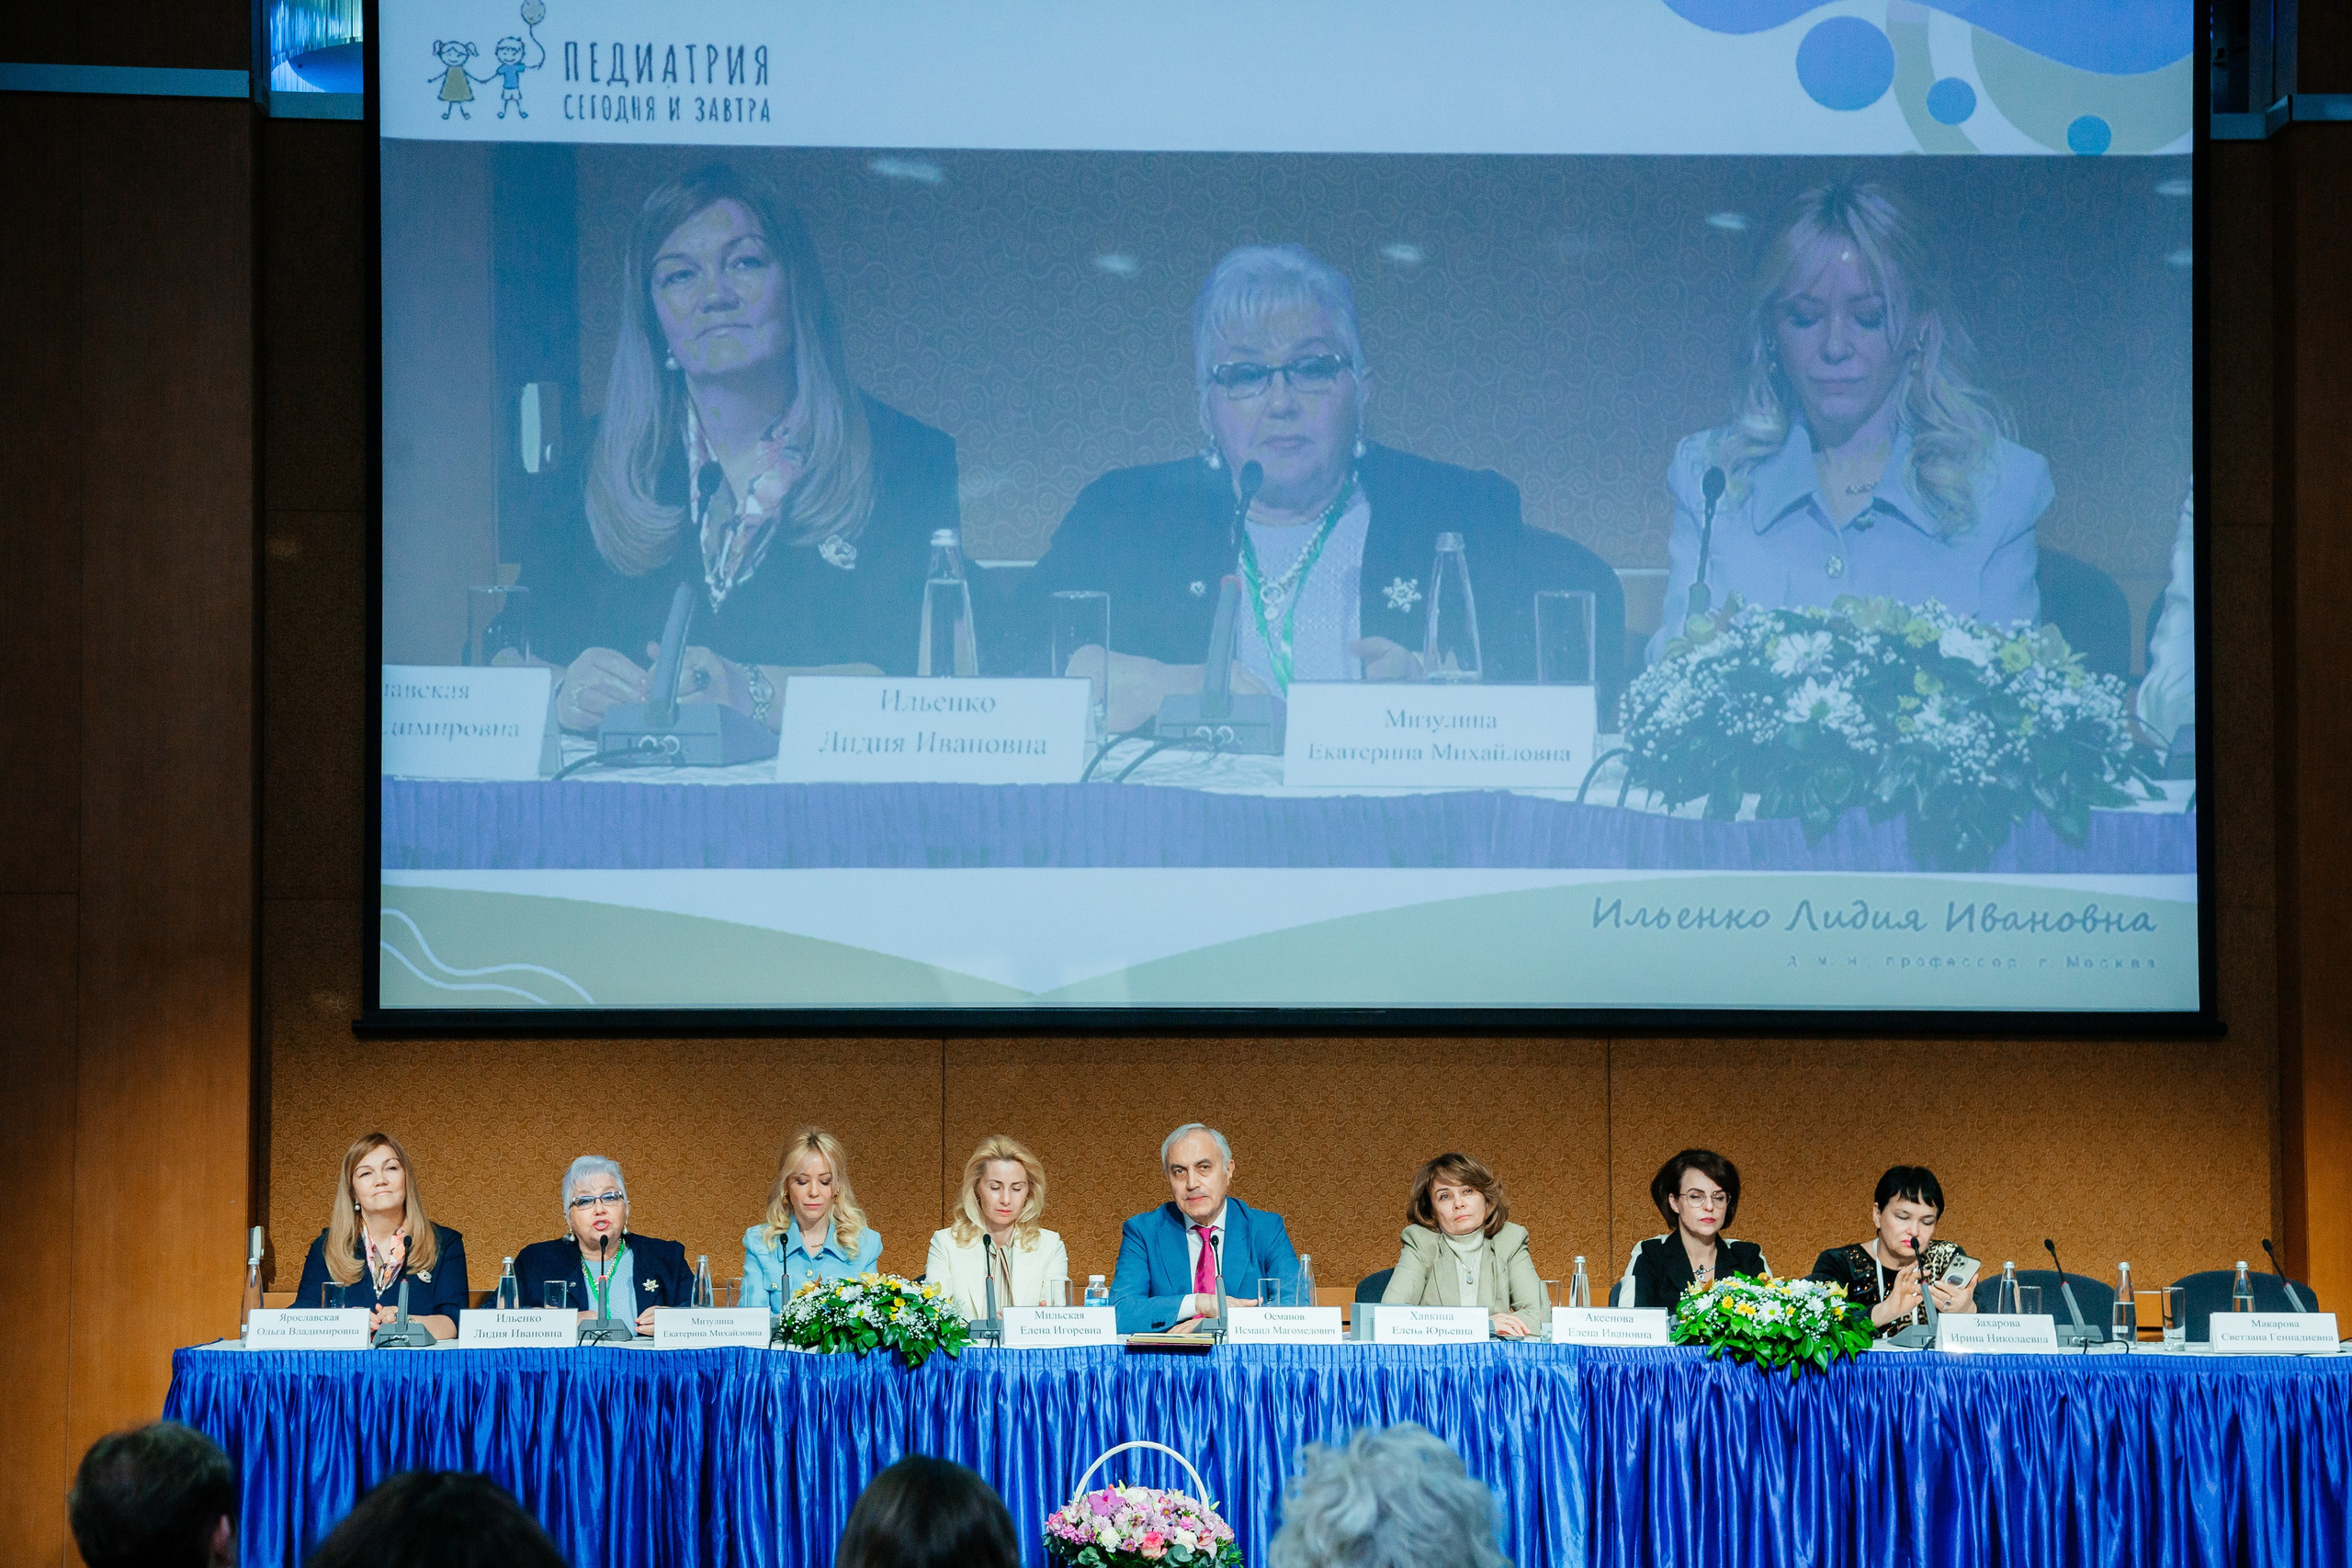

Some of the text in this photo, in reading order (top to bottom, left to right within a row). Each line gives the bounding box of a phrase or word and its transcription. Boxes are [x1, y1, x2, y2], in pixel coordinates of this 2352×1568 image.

[563, 40, 769, 88] ПЕДИАТРИЯ
[563, 94, 771, 124] СЕГОДНЯ И ЗАВТРА
[880, 688, 996, 714] Ильенко
[1385, 708, 1498, 734] Мизулина
[819, 730, 1047, 755] Лидия Ивановна
[1308, 741, 1572, 765] Екатерина Михайловна
[1593, 897, 2159, 934] Ильенко Лидия Ивановна
[279, 1314, 340, 1323] Ярославская
[496, 1314, 542, 1323] Ильенко
[1035, 1311, 1085, 1320] Мильская
[1264, 1312, 1306, 1321] Османов
[1410, 1311, 1454, 1321] Хавкина
[1585, 1313, 1634, 1323] Аксенова
[691, 1317, 734, 1326] Мизулина
[1973, 1317, 2021, 1329] Захарова
[2251, 1319, 2300, 1329] Макарова
[256, 1327, 359, 1337] Ольга Владимировна
[473, 1329, 562, 1338] Лидия Ивановна
[663, 1330, 707, 1338] Екатерина
[1020, 1325, 1102, 1337] Елена Игоревна
[1235, 1325, 1336, 1336] Исмаил Магомедович
[1392, 1325, 1474, 1337] Елена Юрьевна
[1568, 1327, 1652, 1339] Елена Ивановна
[1951, 1333, 2049, 1344] Ирина Николаевна
[2222, 1333, 2334, 1341] Светлана Геннадиевна
